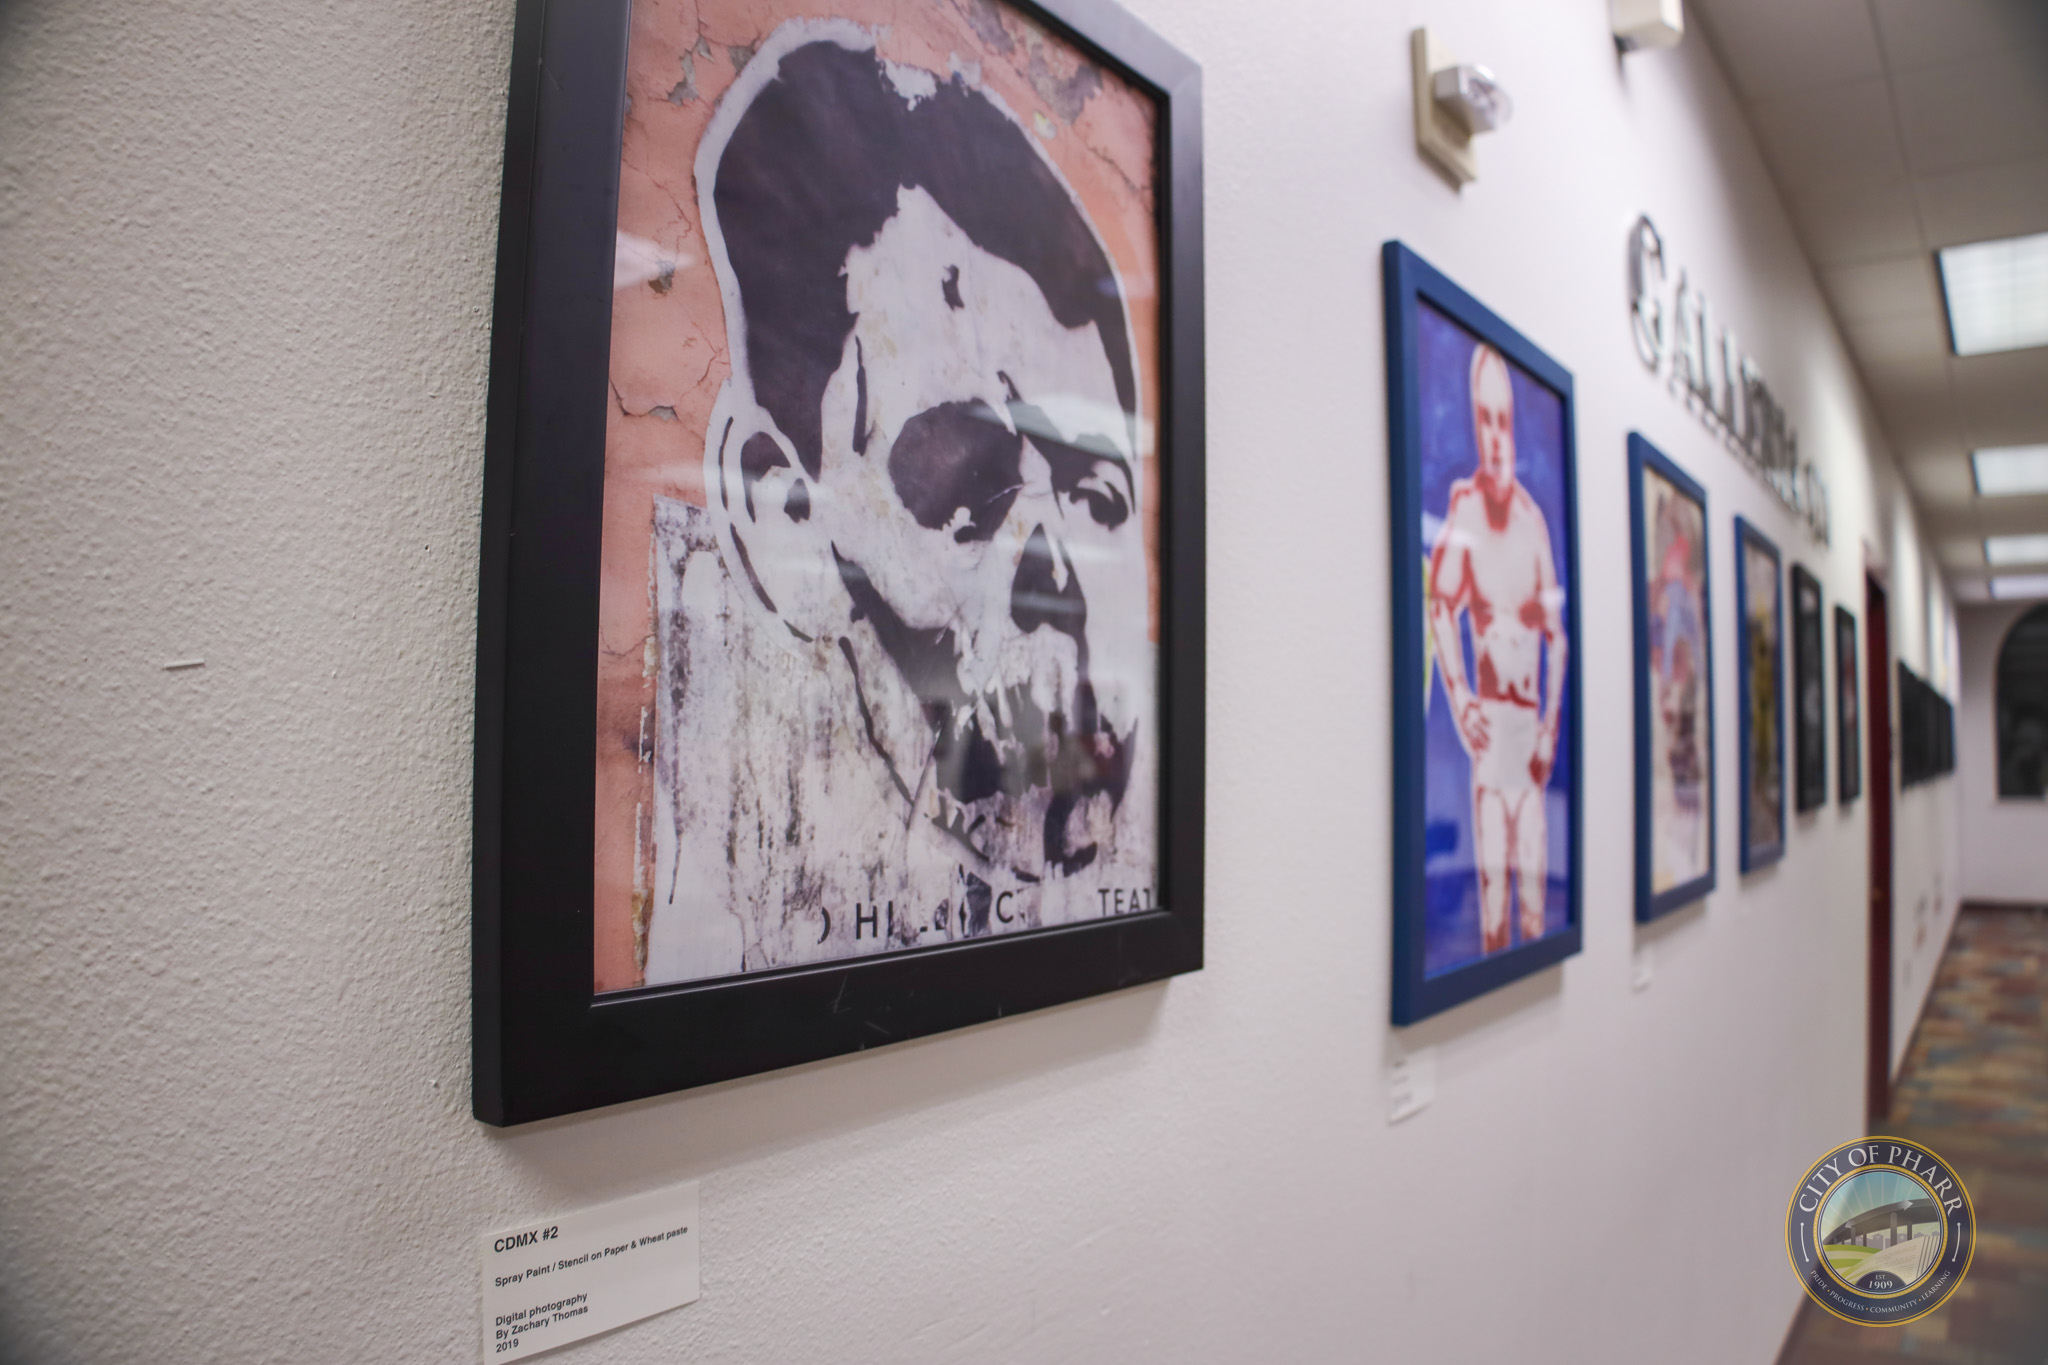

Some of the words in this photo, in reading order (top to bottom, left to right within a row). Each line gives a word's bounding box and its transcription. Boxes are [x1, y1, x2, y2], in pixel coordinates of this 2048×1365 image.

[494, 1230, 539, 1253] CDMX
[543, 1226, 559, 1241] #2
[495, 1273, 523, 1287] Spray
[526, 1265, 550, 1278] Paint
[558, 1253, 589, 1270] Stencil
[591, 1251, 602, 1261] on
[604, 1243, 629, 1257] Paper
[630, 1240, 637, 1249] &
[639, 1232, 664, 1246] Wheat
[666, 1226, 688, 1240] paste
[495, 1309, 527, 1326] Digital
[529, 1293, 588, 1318] photography
[496, 1329, 509, 1339] By
[512, 1317, 550, 1335] Zachary
[552, 1306, 588, 1322] Thomas
[496, 1338, 519, 1353] 2019
